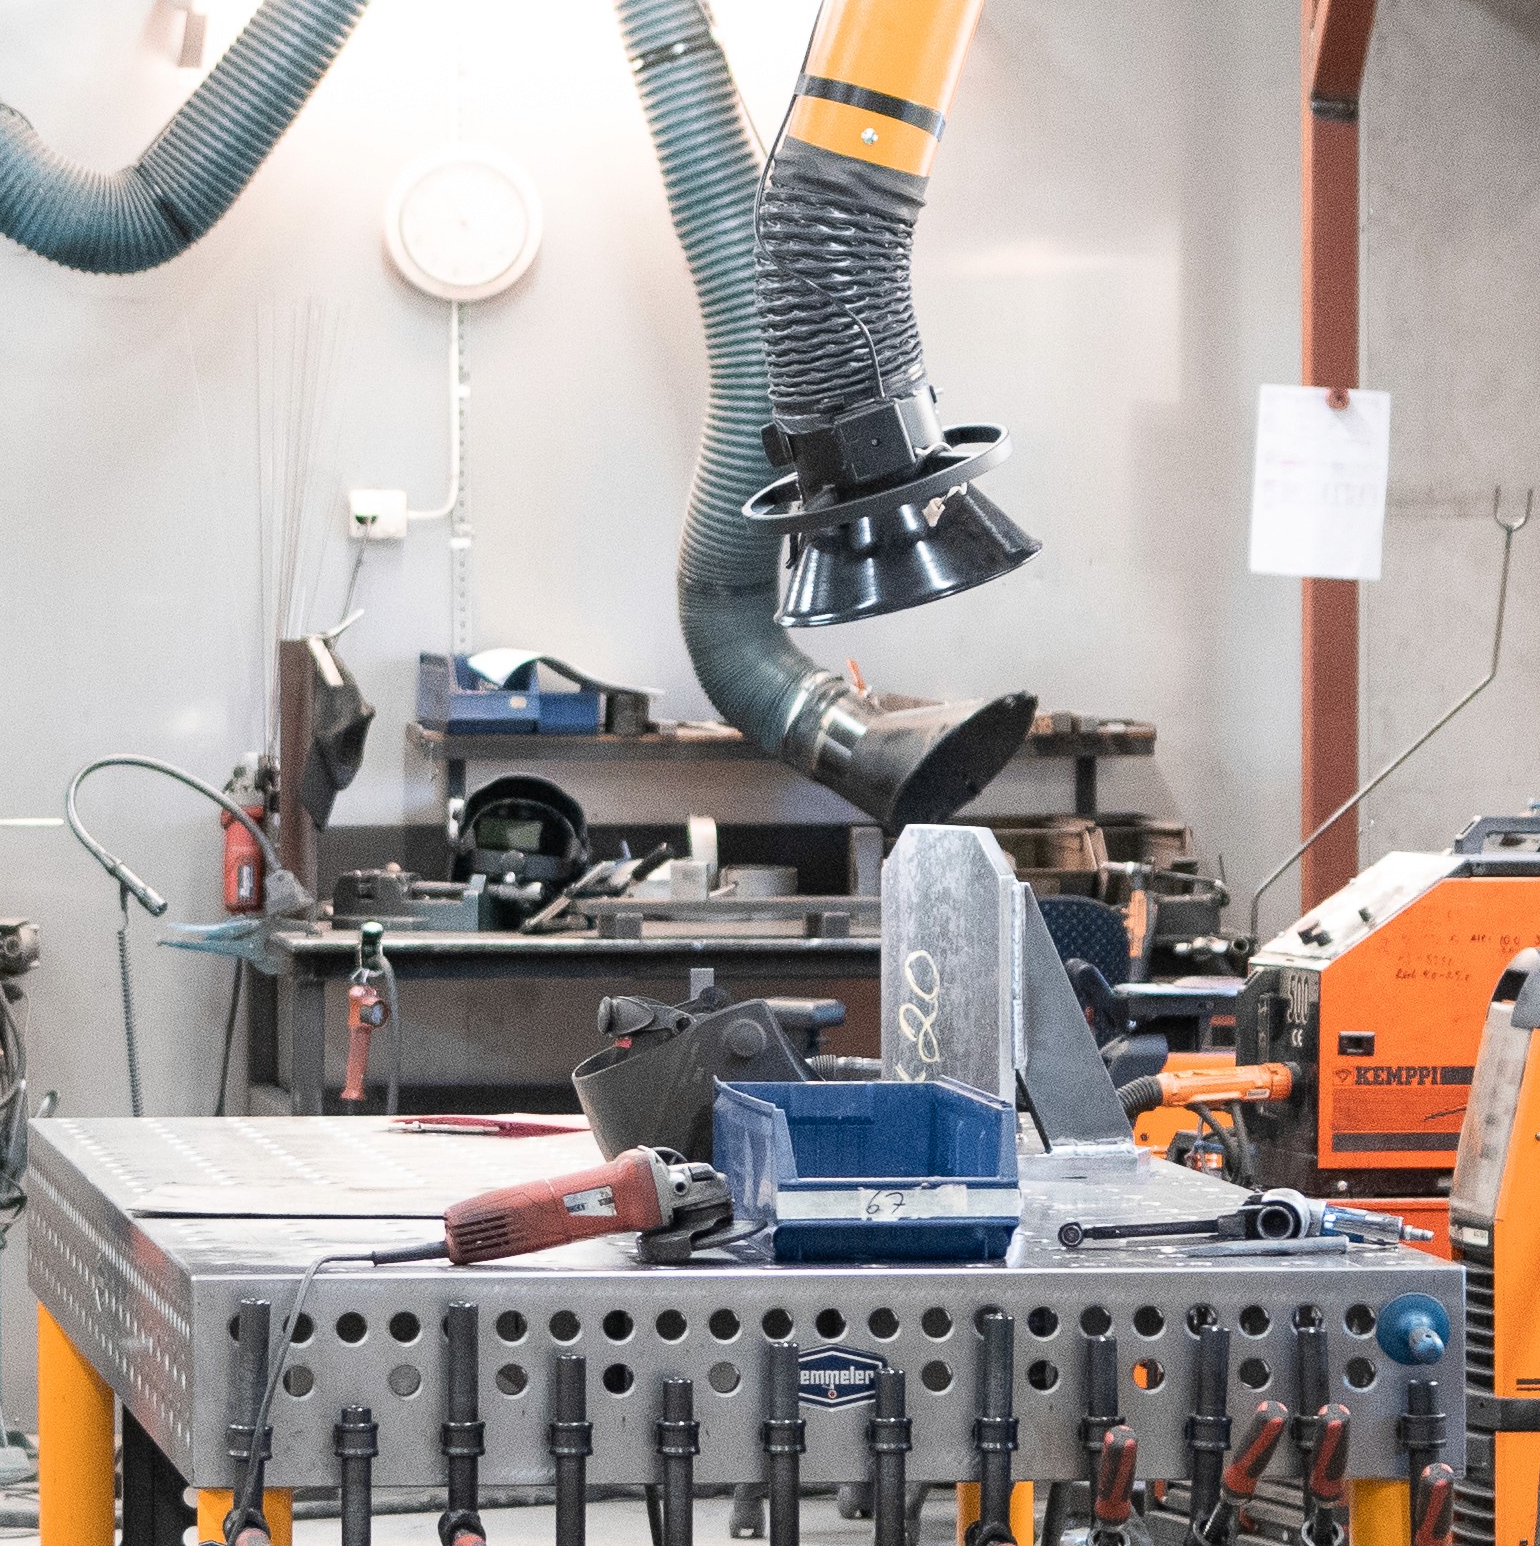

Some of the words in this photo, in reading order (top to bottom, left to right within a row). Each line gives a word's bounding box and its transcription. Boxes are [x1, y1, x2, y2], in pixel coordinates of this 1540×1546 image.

[1355, 1066, 1440, 1086] KEMPPI
[866, 1191, 906, 1214] 67
[800, 1365, 874, 1389] emmeler
